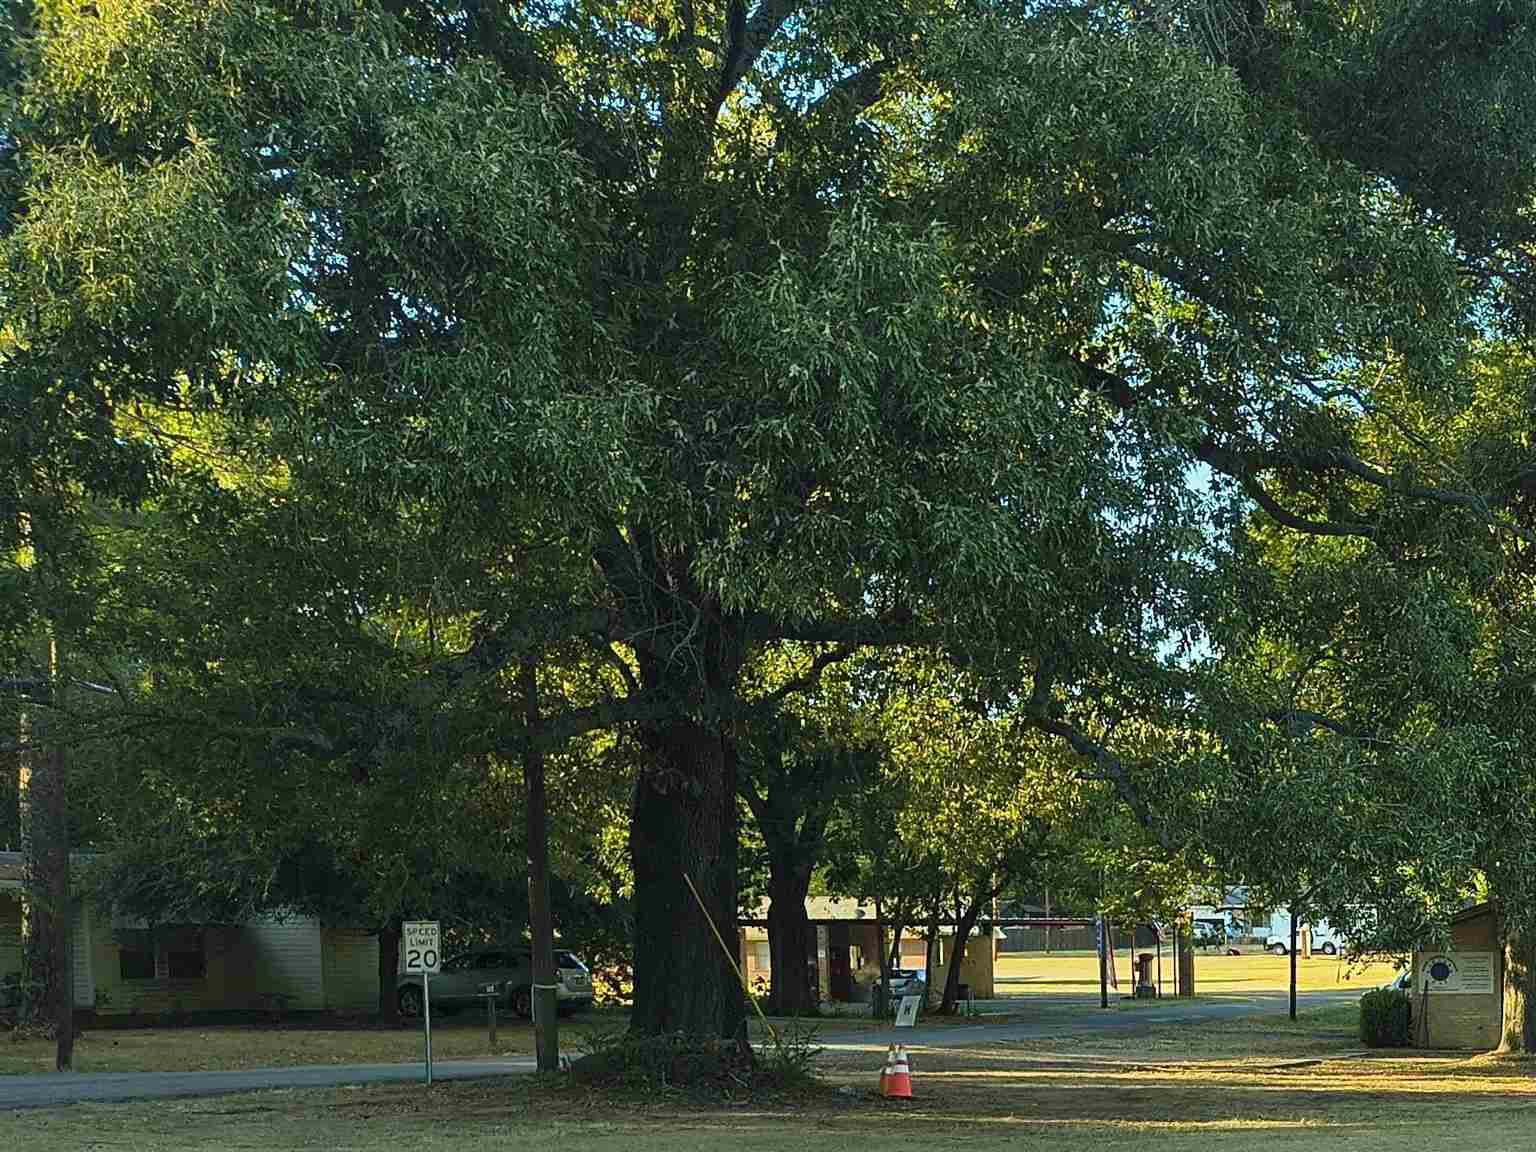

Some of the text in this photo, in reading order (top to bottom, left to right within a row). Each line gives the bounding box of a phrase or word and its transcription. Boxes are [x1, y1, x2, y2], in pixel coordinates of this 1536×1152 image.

[406, 927, 437, 936] SPEED
[410, 938, 433, 947] LIMIT
[407, 950, 437, 968] 20
